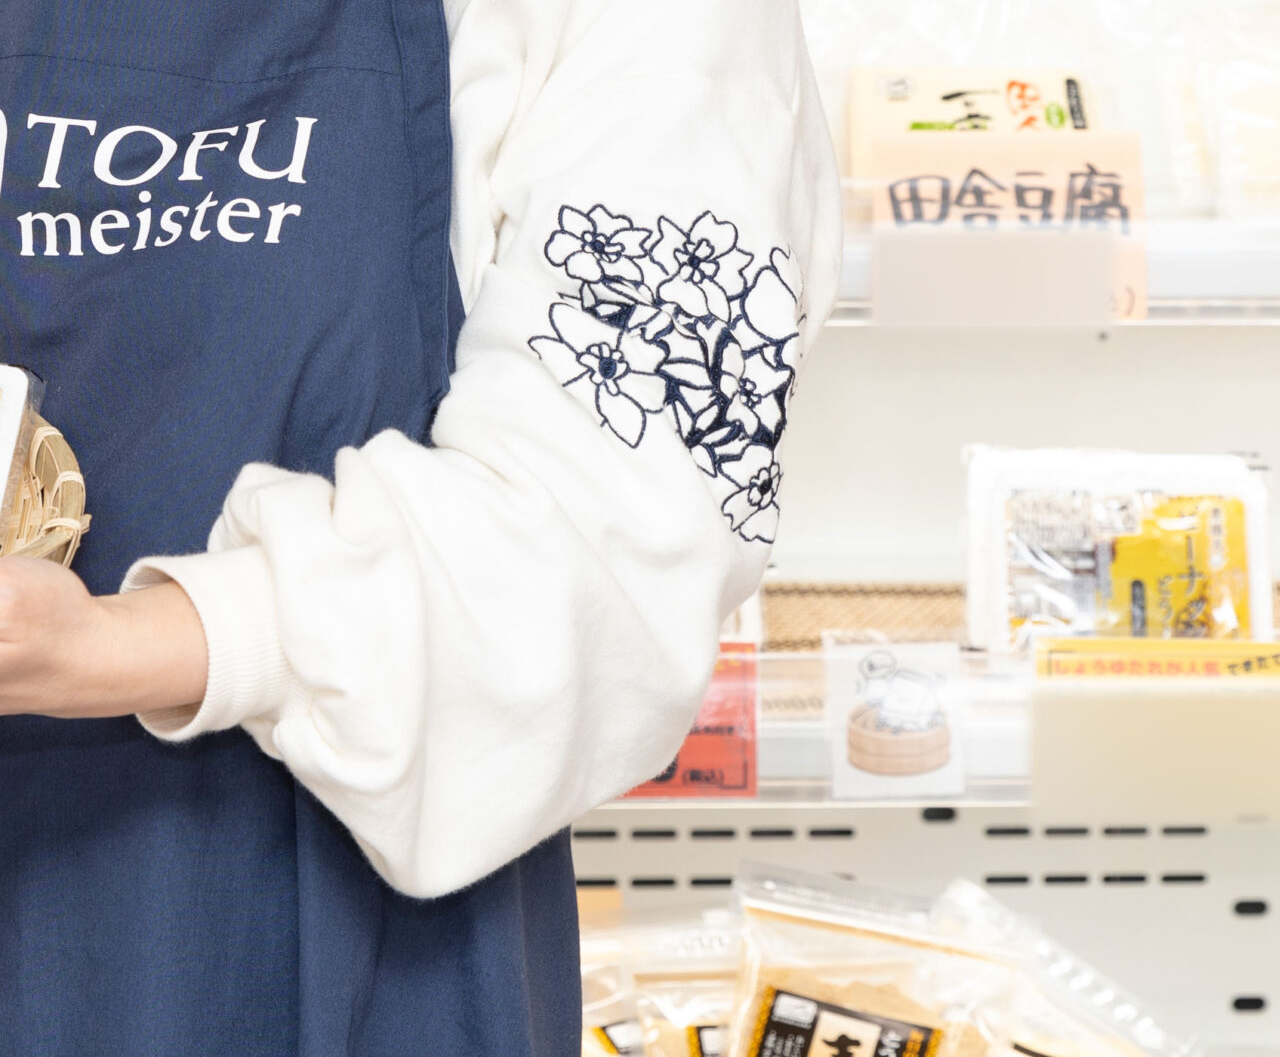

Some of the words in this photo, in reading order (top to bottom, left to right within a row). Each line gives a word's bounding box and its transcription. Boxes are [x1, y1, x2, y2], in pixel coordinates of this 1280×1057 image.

[26, 112, 319, 190] TOFU
[16, 190, 303, 258] meister
[888, 161, 1132, 235] 田舎豆腐
